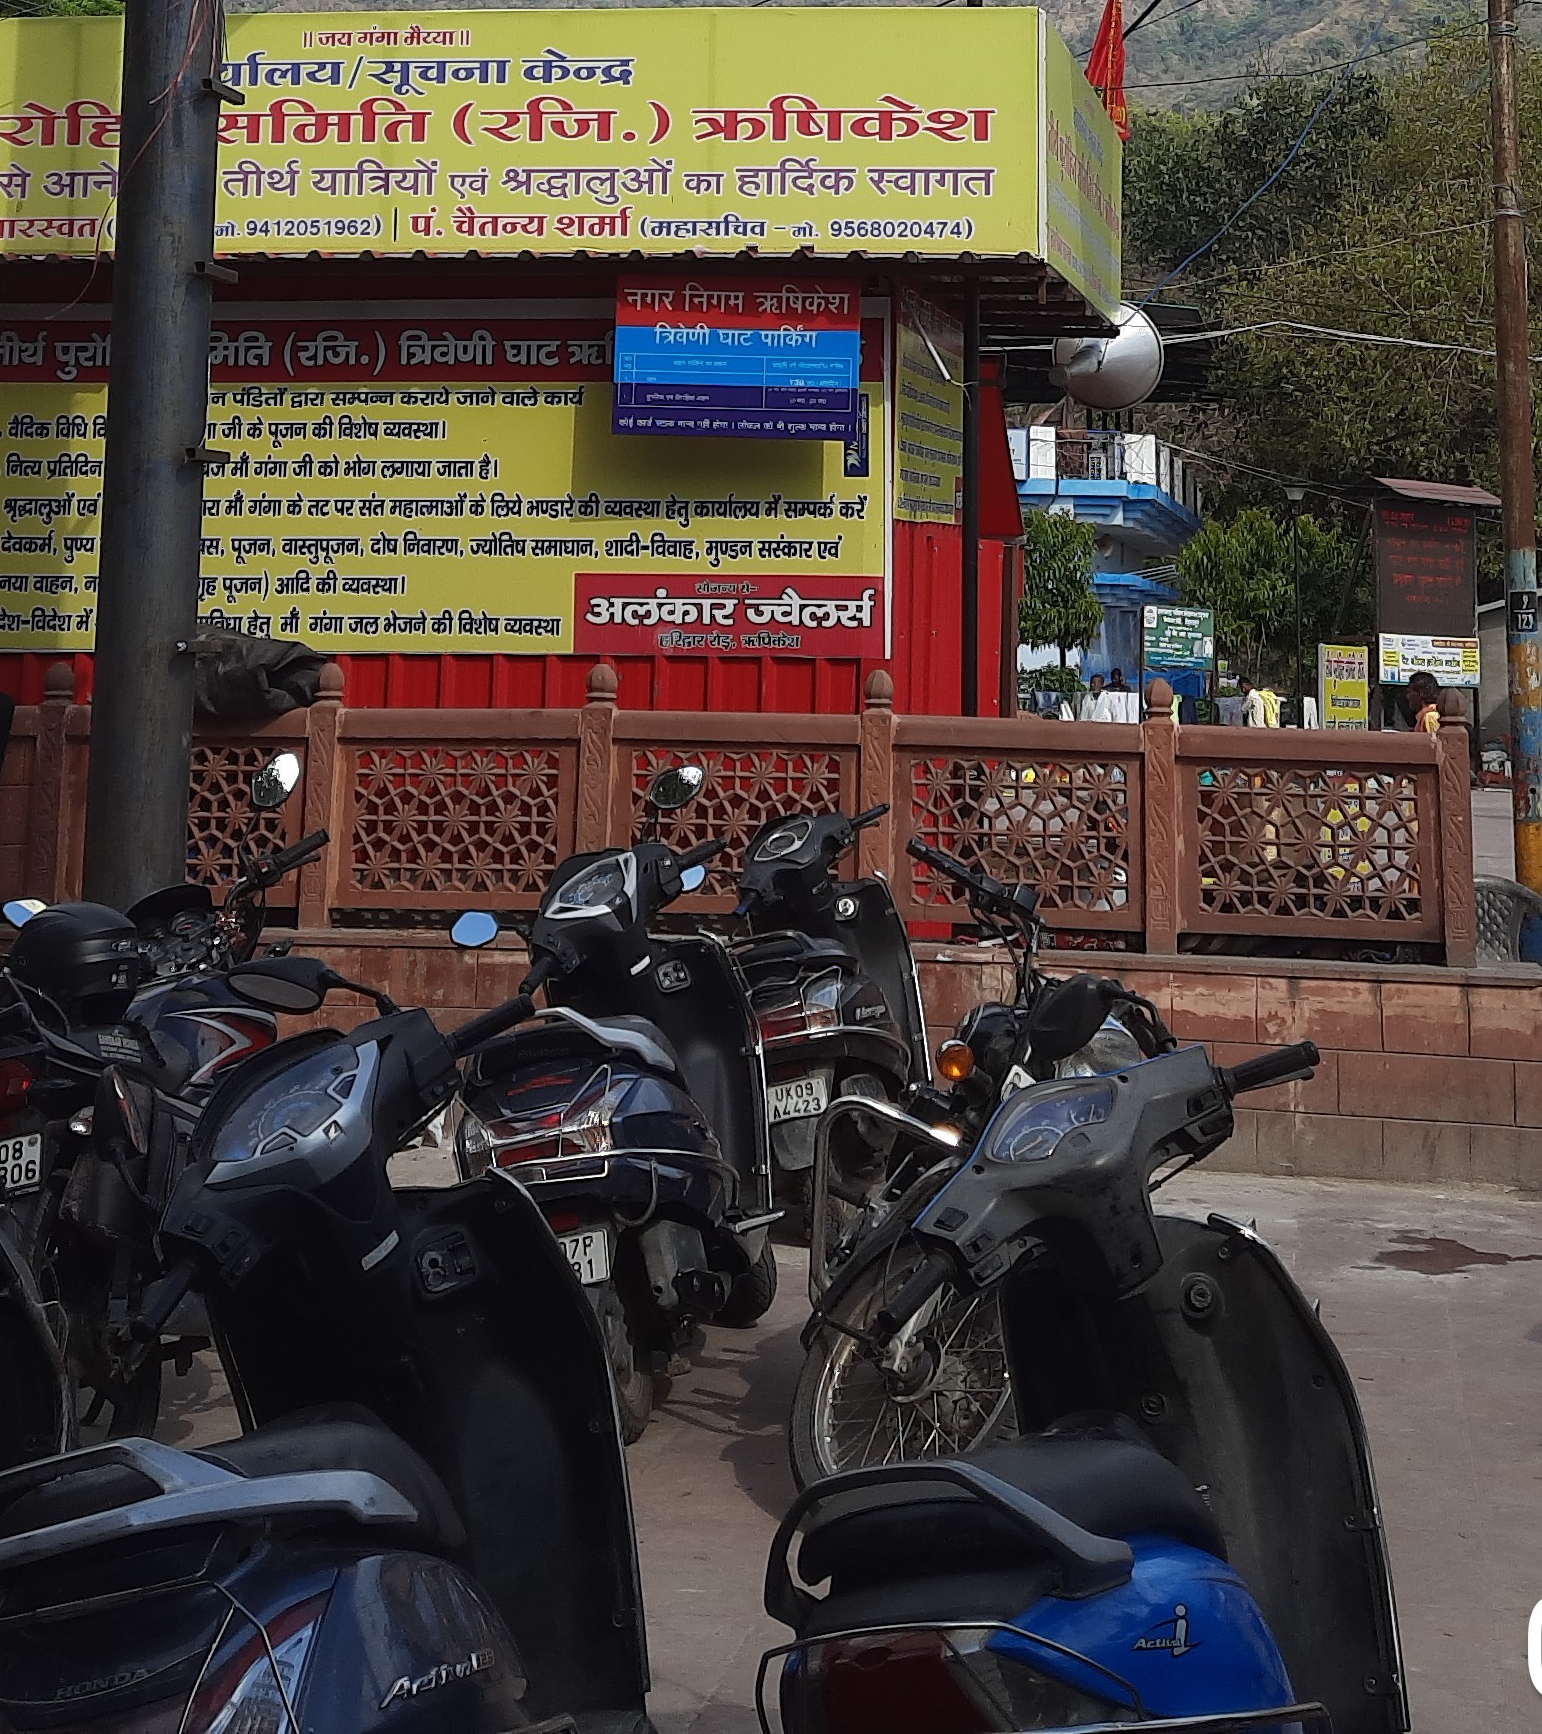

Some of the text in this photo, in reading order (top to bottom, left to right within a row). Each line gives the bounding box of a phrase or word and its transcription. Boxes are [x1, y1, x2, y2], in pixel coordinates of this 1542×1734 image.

[358, 28, 398, 47] गंगा
[522, 49, 635, 87] केन्द्र
[453, 95, 672, 145] (रजि.)
[222, 159, 298, 197] तीर्थ
[311, 159, 437, 198] यात्रियों
[450, 166, 488, 197] एवं
[684, 170, 723, 197] का
[737, 157, 855, 197] हार्दिक
[867, 166, 995, 198] स्वागत
[555, 206, 632, 238] शर्मा
[624, 283, 850, 315] नगर निगम ऋषिकेश
[654, 322, 710, 347] त्रिवेणी
[717, 328, 753, 347] घाट
[503, 339, 560, 366] घाट
[456, 387, 495, 406] जाने
[502, 386, 538, 406] वाले
[543, 385, 585, 407] कार्य
[8, 415, 50, 440] वैदिक
[221, 417, 243, 441] जी
[247, 417, 264, 440] के
[268, 420, 307, 448] पूजन
[6, 453, 42, 478] नित्य
[254, 457, 288, 479] गंगा
[292, 457, 313, 479] जी
[317, 455, 340, 478] को
[344, 457, 377, 478] भोग
[381, 460, 431, 479] लगाया
[436, 460, 475, 479] जाता
[248, 494, 282, 517] गंगा
[287, 492, 305, 517] के
[309, 498, 330, 517] तट
[334, 498, 354, 517] पर
[359, 492, 384, 518] संत
[469, 494, 487, 518] के
[578, 492, 601, 519] की
[664, 493, 690, 527] हेतु
[316, 570, 338, 595] की
[309, 609, 344, 635] गंगा
[348, 617, 379, 635] जल
[431, 609, 453, 635] की
[585, 586, 875, 627] अलंकार ज्वैलर्स
